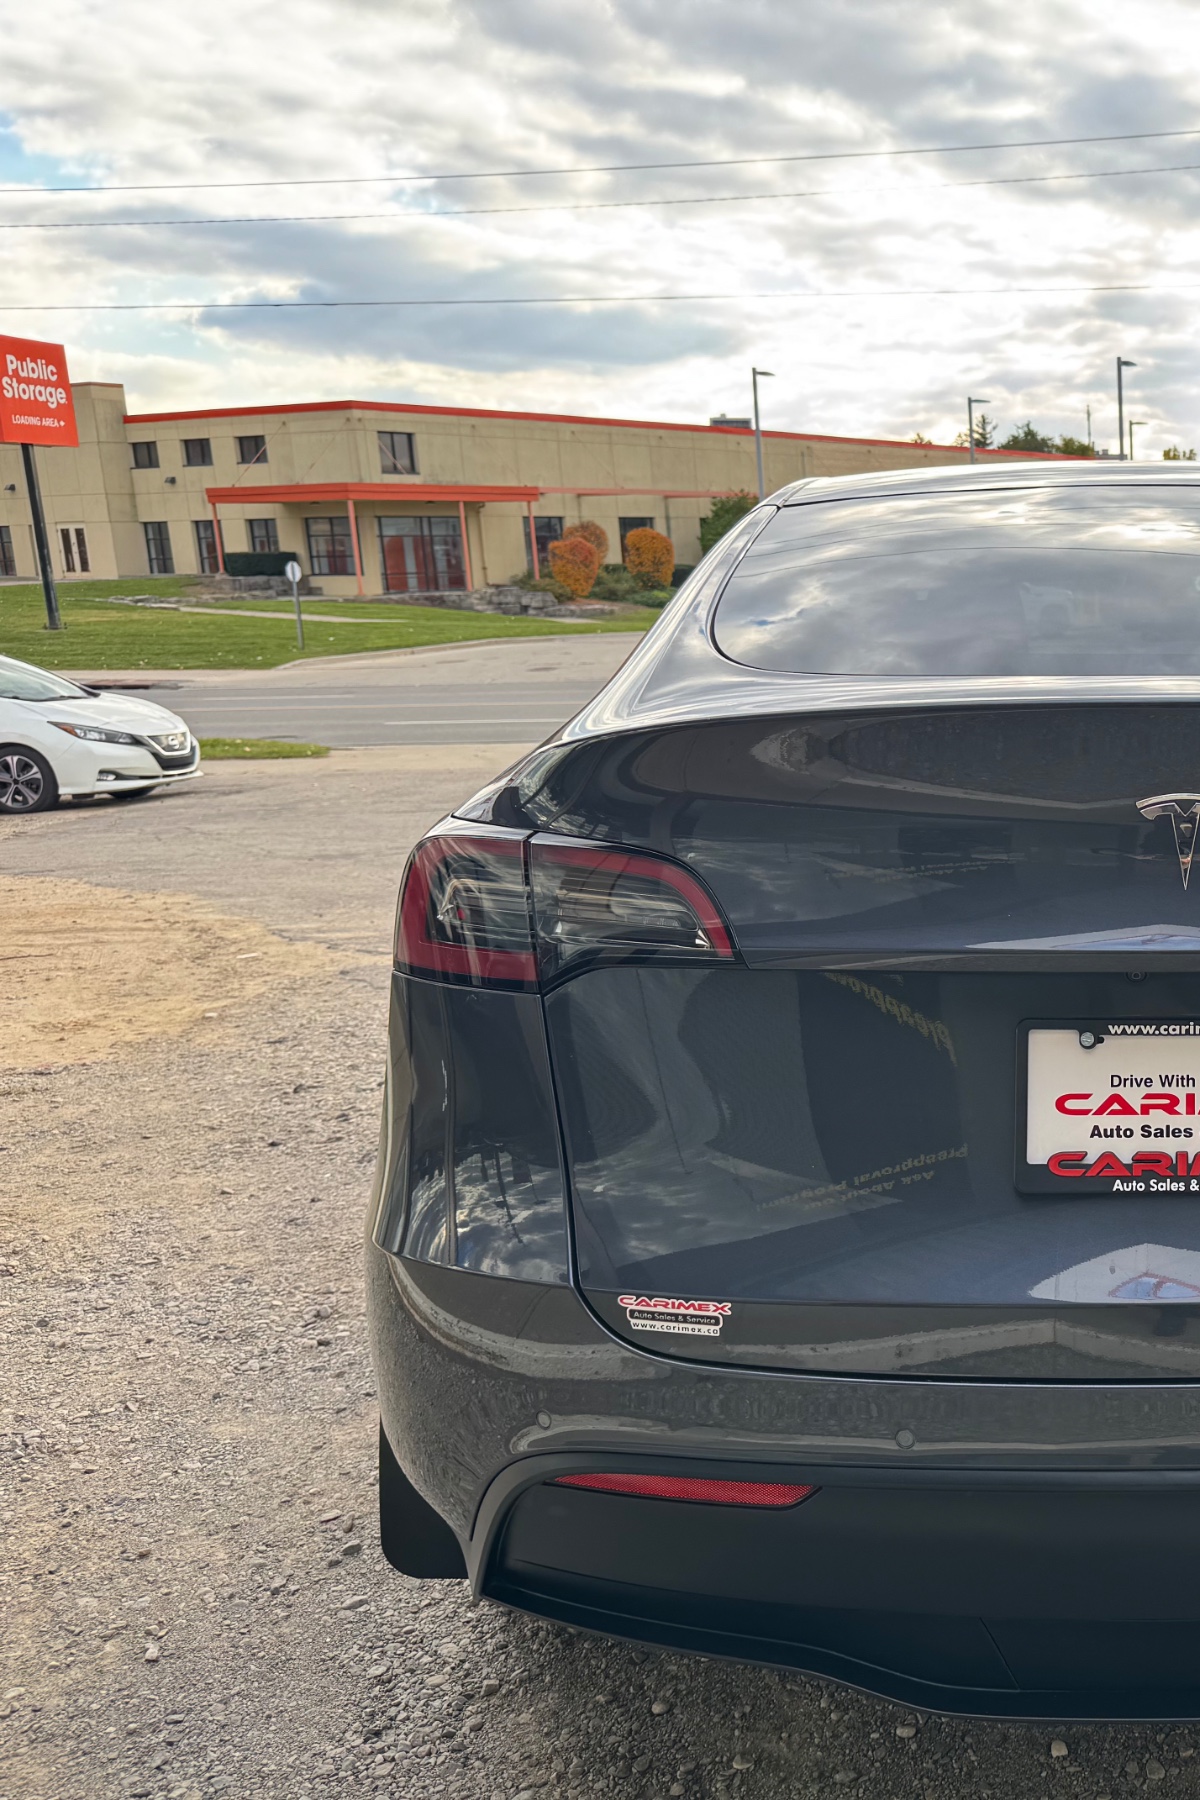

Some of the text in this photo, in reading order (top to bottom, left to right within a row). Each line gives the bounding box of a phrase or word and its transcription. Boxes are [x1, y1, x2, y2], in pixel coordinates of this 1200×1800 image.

[6, 353, 58, 382] Public
[2, 376, 67, 409] Storage
[11, 414, 60, 428] LOADING AREA
[1109, 1074, 1154, 1089] Drive
[1158, 1073, 1196, 1088] With
[1089, 1124, 1135, 1139] Auto
[1140, 1124, 1194, 1139] Sales
[1112, 1178, 1146, 1193] Auto
[1149, 1178, 1186, 1193] Sales
[1189, 1179, 1200, 1193] &
[619, 1296, 731, 1314] CARIMEX
[633, 1311, 653, 1319] Auto
[654, 1312, 676, 1322] Sales
[686, 1315, 716, 1325] Service
[632, 1321, 719, 1335] www.carimex.ca
